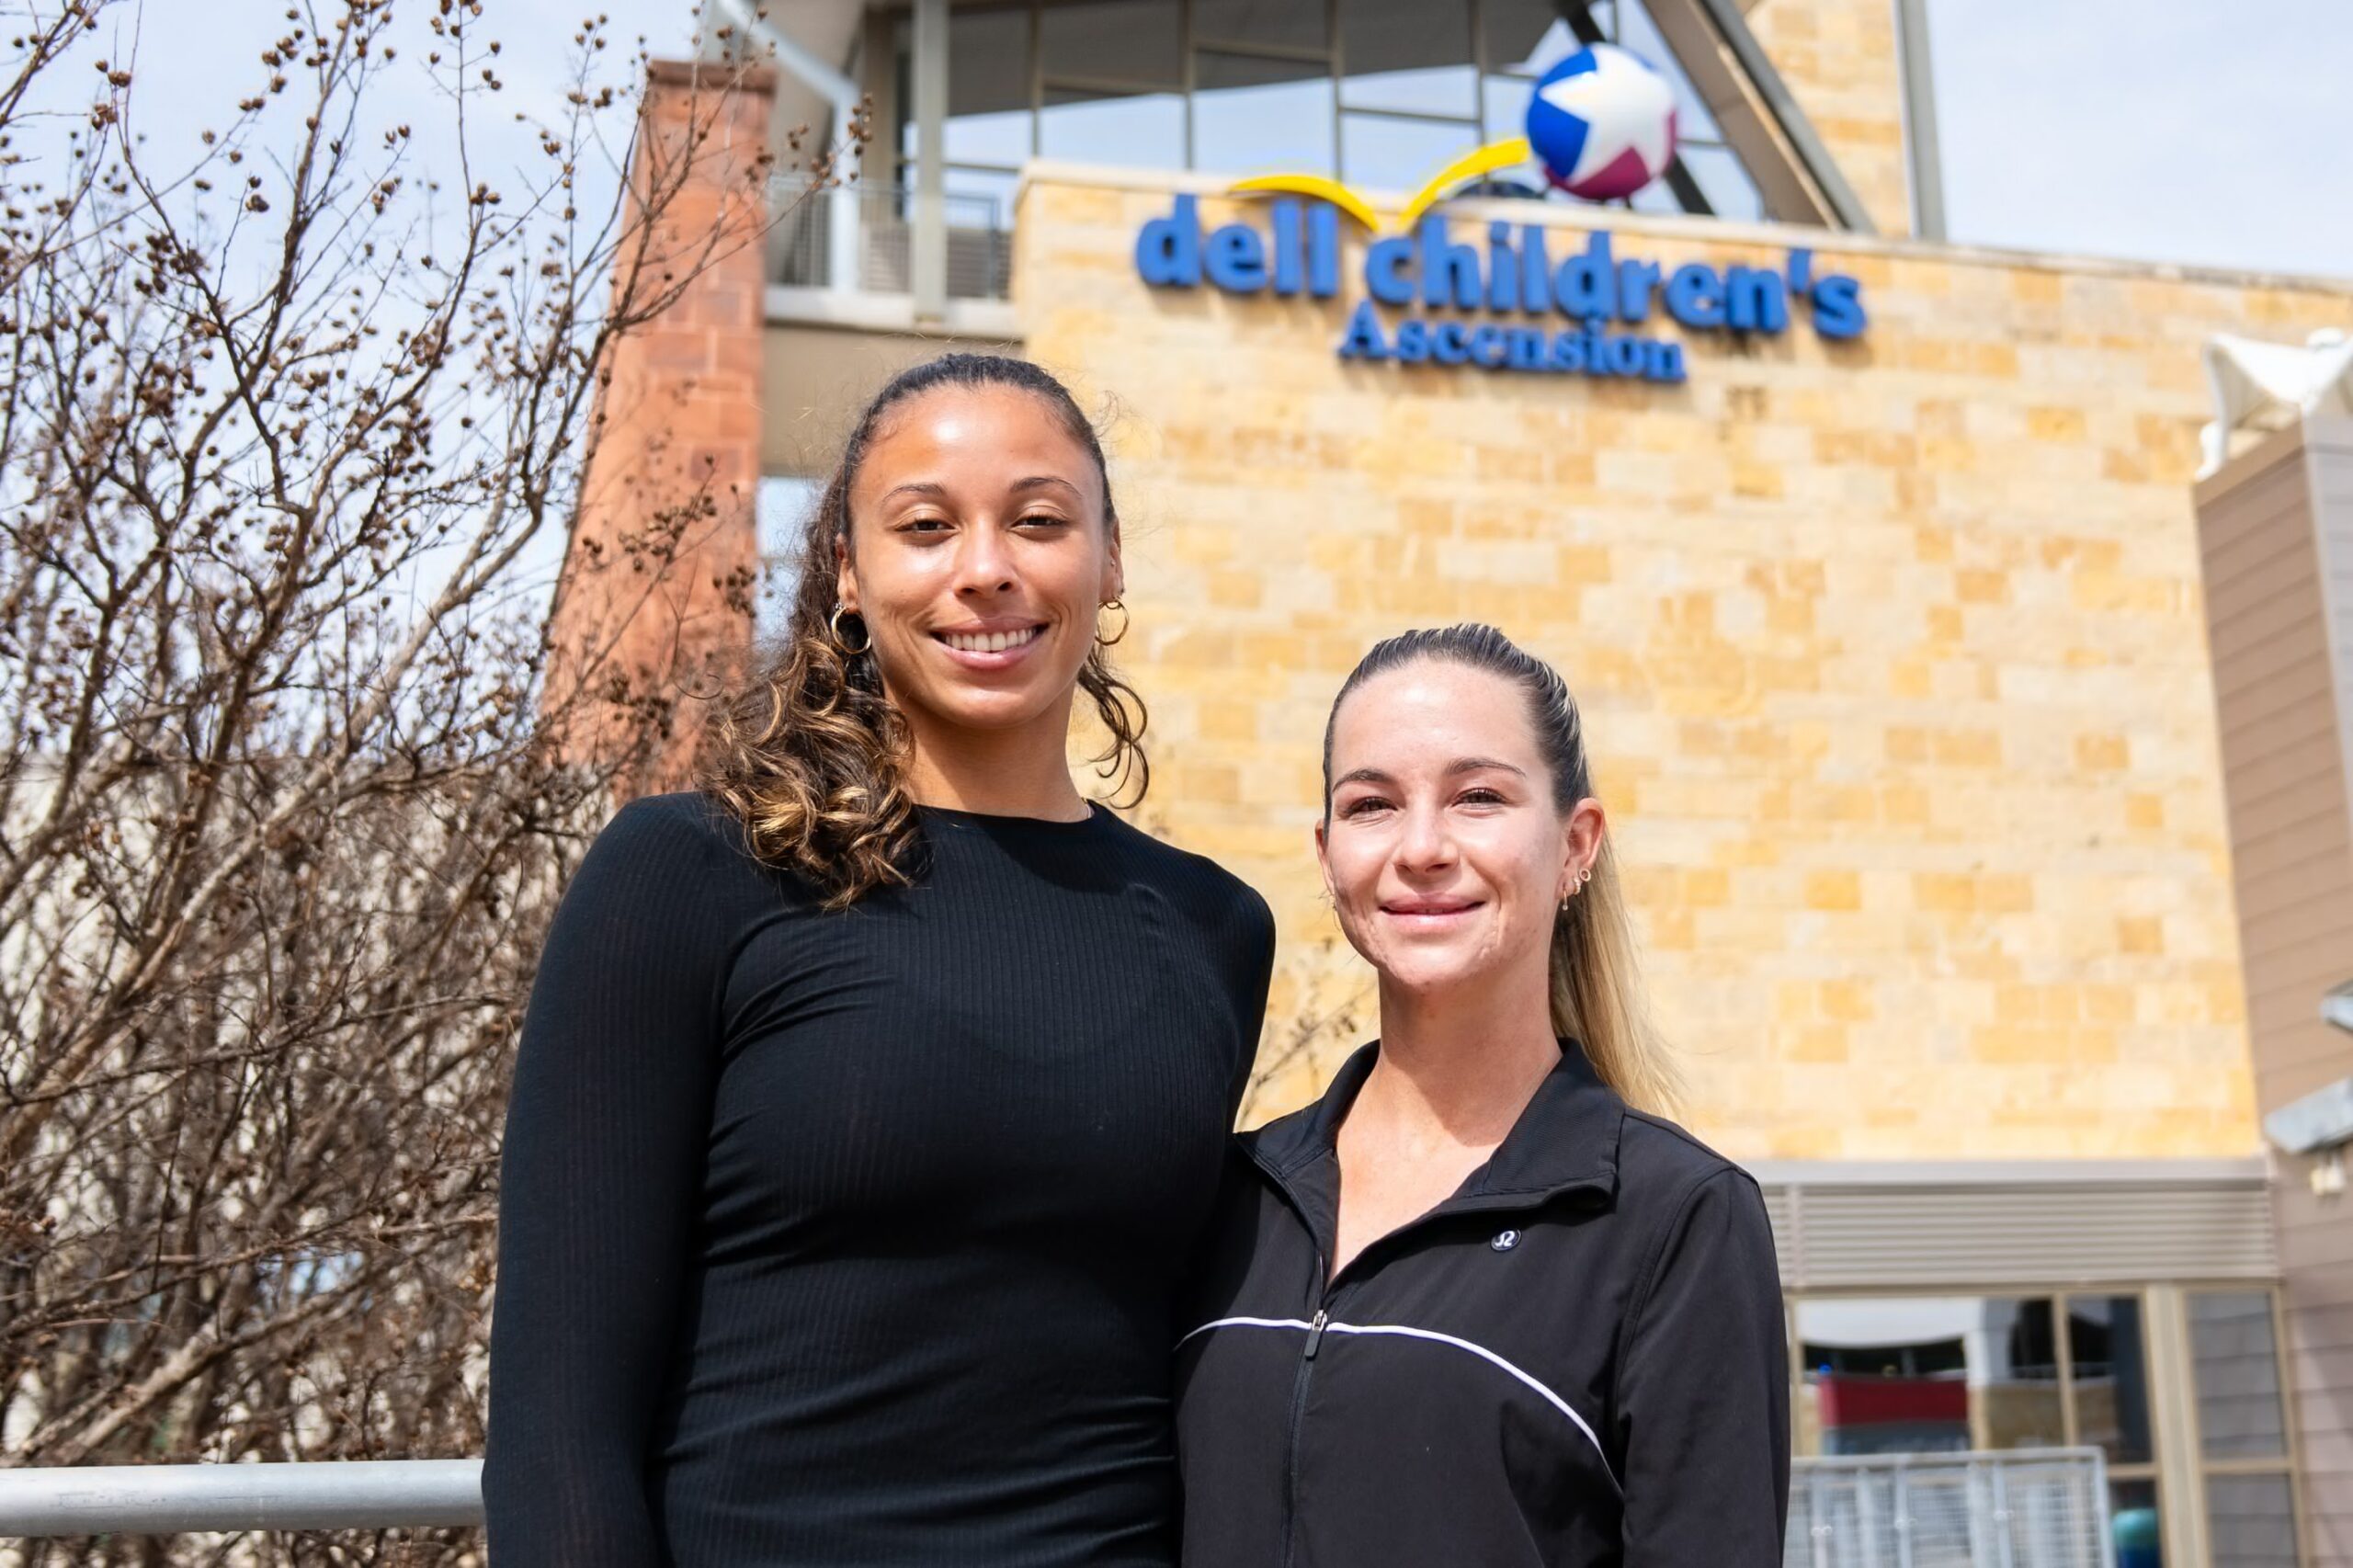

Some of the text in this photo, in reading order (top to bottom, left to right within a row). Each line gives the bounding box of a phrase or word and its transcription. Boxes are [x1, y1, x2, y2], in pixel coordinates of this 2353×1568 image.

[1136, 194, 1866, 338] dell children's
[1337, 299, 1688, 381] Ascension
